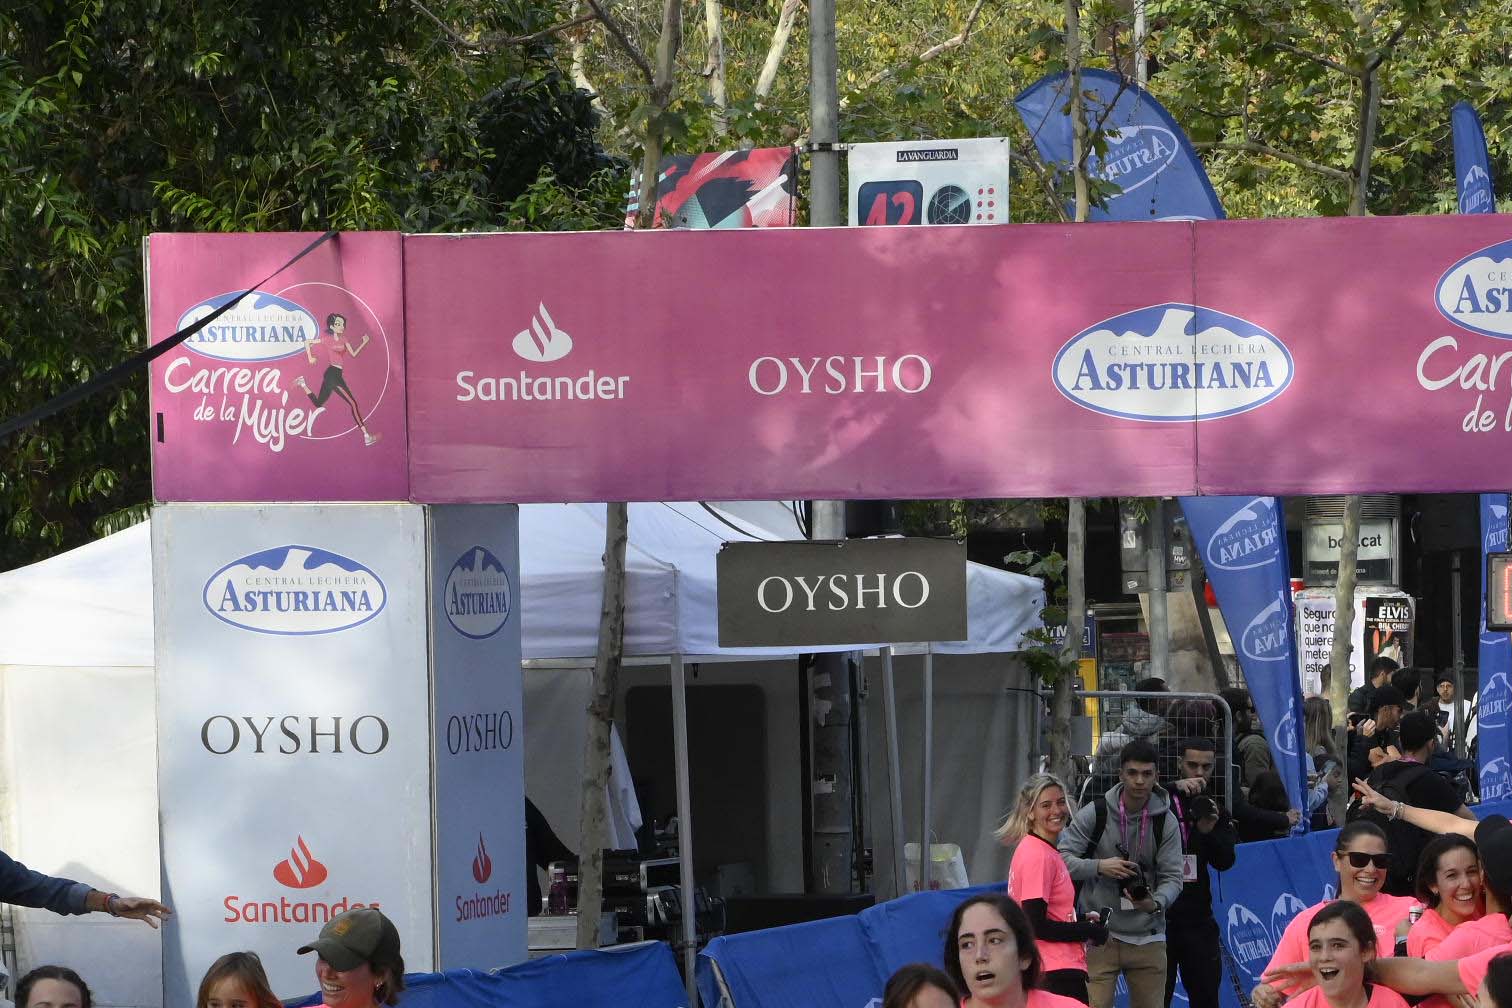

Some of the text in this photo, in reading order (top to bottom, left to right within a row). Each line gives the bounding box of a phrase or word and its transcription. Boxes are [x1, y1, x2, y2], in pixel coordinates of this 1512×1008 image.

[187, 315, 308, 344] ASTURIANA
[1108, 342, 1268, 358] CENTRAL LECHERA
[164, 356, 282, 394] Carrera
[455, 369, 631, 403] Santander
[748, 353, 933, 396] OYSHO
[1071, 348, 1276, 392] ASTURIANA
[193, 390, 327, 453] de la Mujer
[1461, 394, 1497, 433] de
[218, 578, 374, 614] ASTURIANA
[245, 575, 368, 587] CENTRAL LECHERA
[450, 580, 508, 616] ASTURIANA
[757, 570, 931, 614] OYSHO
[1304, 624, 1320, 634] que
[1378, 606, 1409, 619] ELVIS
[200, 714, 391, 756] OYSHO
[446, 709, 514, 756] OYSHO
[223, 895, 381, 923] Santand
[455, 888, 512, 923] Santander
